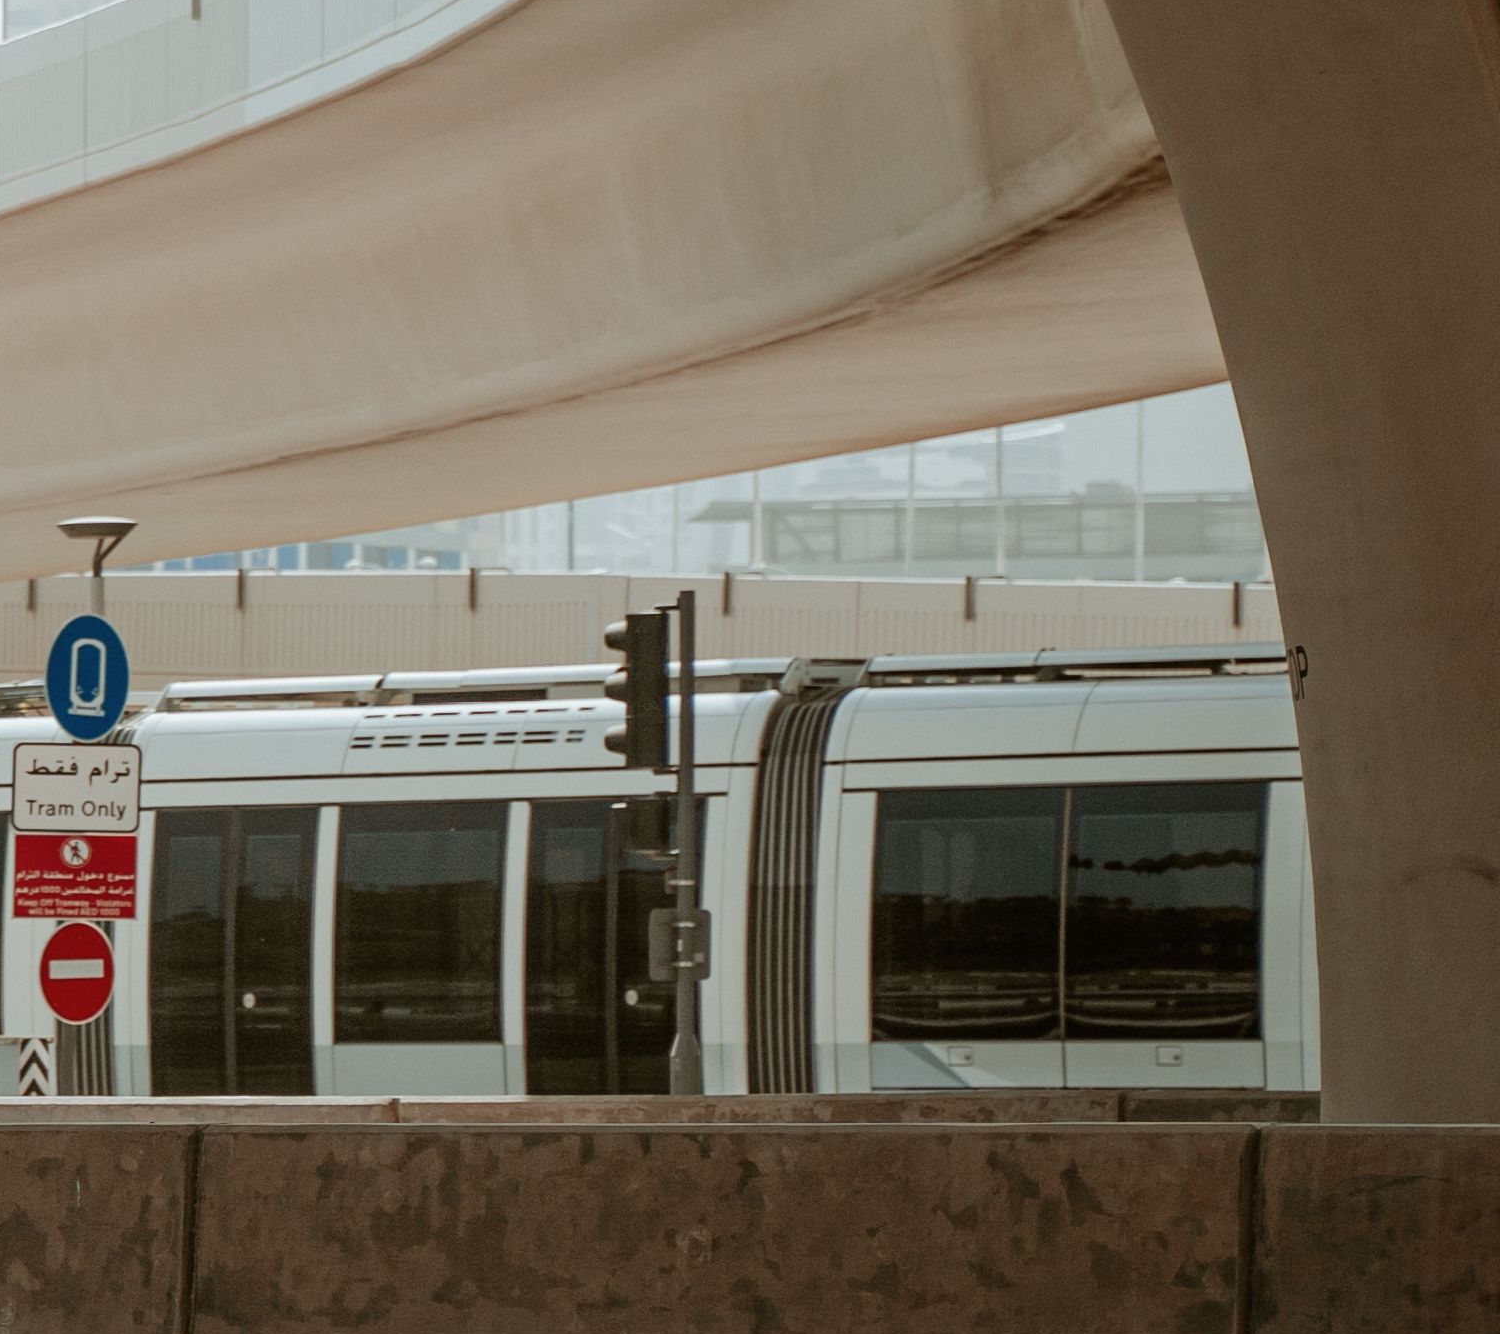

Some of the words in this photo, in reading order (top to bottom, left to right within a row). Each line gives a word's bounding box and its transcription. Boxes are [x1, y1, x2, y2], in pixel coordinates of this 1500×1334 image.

[25, 756, 78, 776] فقط
[88, 759, 130, 787] ترام
[26, 799, 74, 817] Tram
[81, 800, 126, 821] Only
[16, 870, 41, 881] الترام
[42, 870, 74, 880] منطقة
